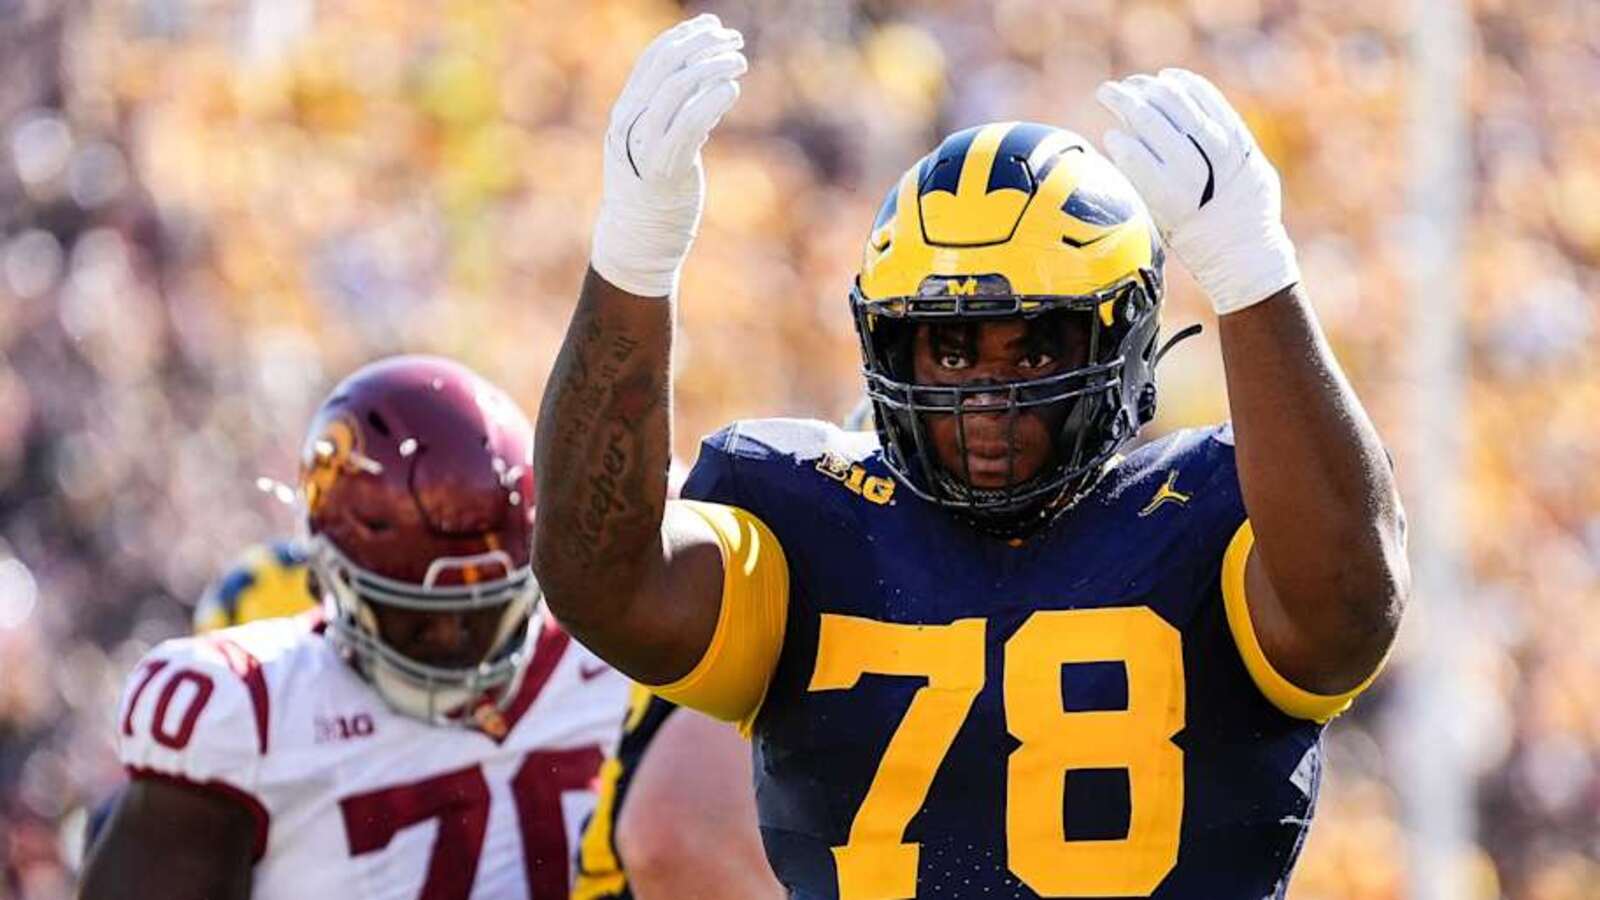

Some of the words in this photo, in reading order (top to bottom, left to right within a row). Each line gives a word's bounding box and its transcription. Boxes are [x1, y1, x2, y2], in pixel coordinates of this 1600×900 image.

[947, 278, 978, 296] M
[123, 658, 215, 750] 70
[807, 605, 1186, 898] 78
